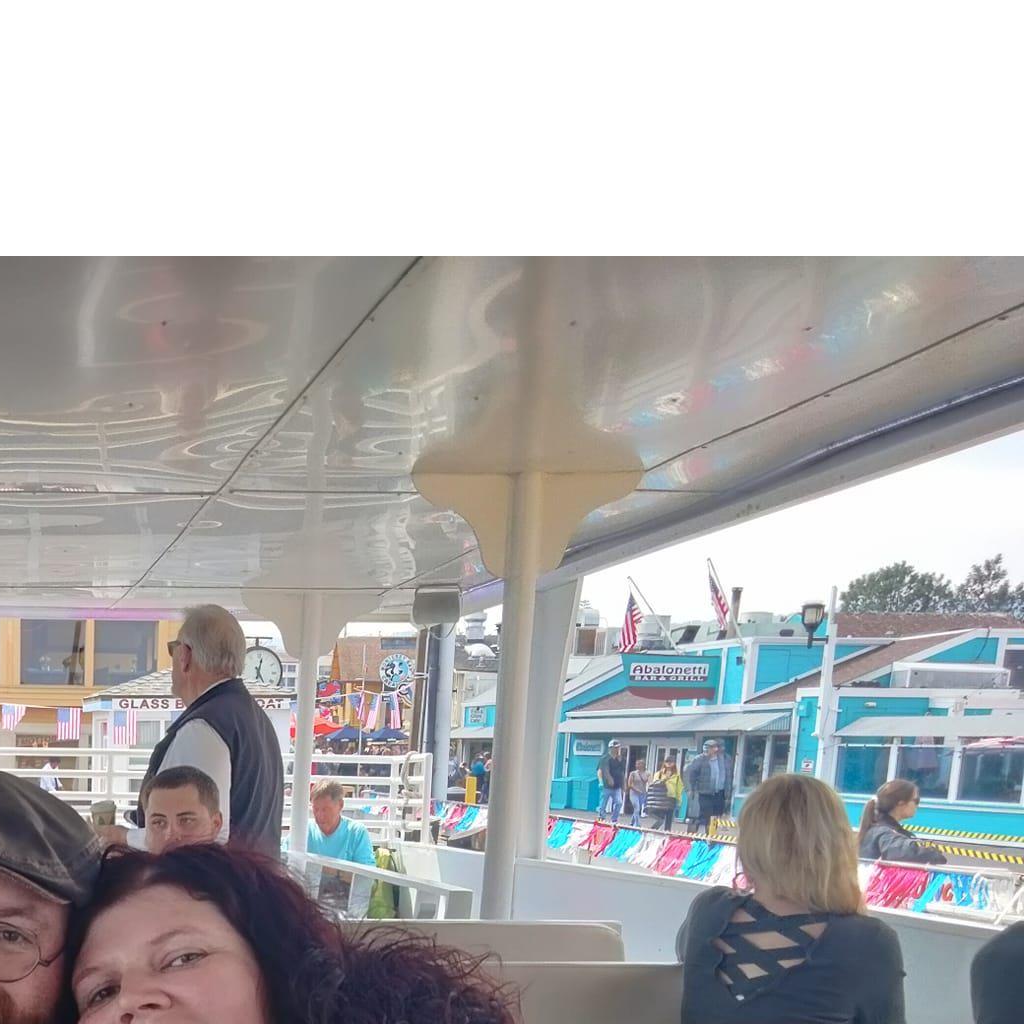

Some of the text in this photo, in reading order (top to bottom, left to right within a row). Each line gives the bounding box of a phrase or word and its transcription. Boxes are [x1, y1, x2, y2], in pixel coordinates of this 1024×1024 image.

[632, 665, 706, 675] Abalonetti
[118, 699, 170, 709] GLASS
[257, 699, 284, 709] OAT
